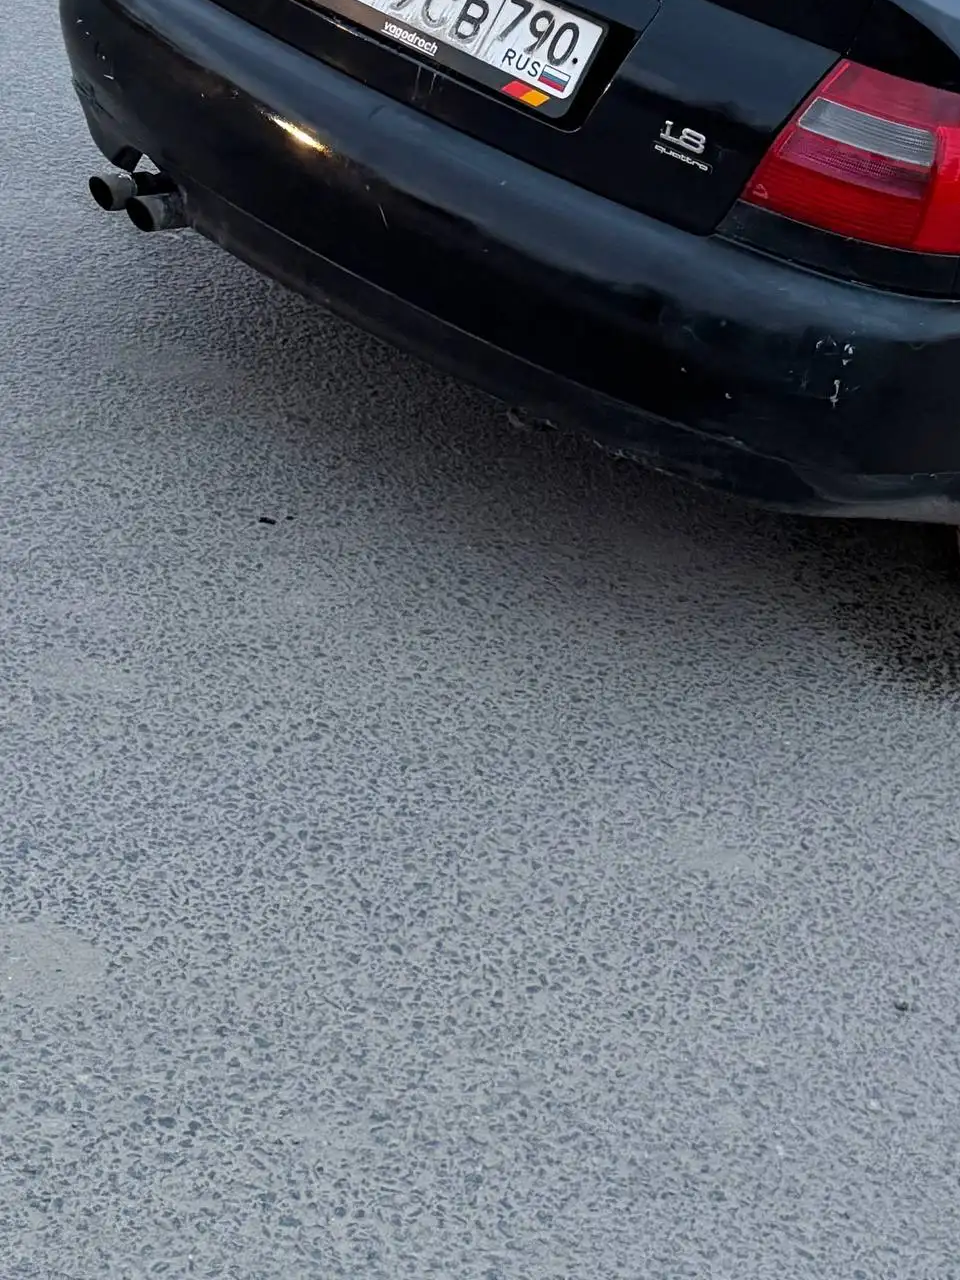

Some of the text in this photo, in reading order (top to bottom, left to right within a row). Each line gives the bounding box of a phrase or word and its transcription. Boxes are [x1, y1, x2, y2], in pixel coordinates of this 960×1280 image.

[383, 21, 438, 55] vagodroch
[501, 47, 543, 79] RUS
[654, 143, 709, 172] quattro
